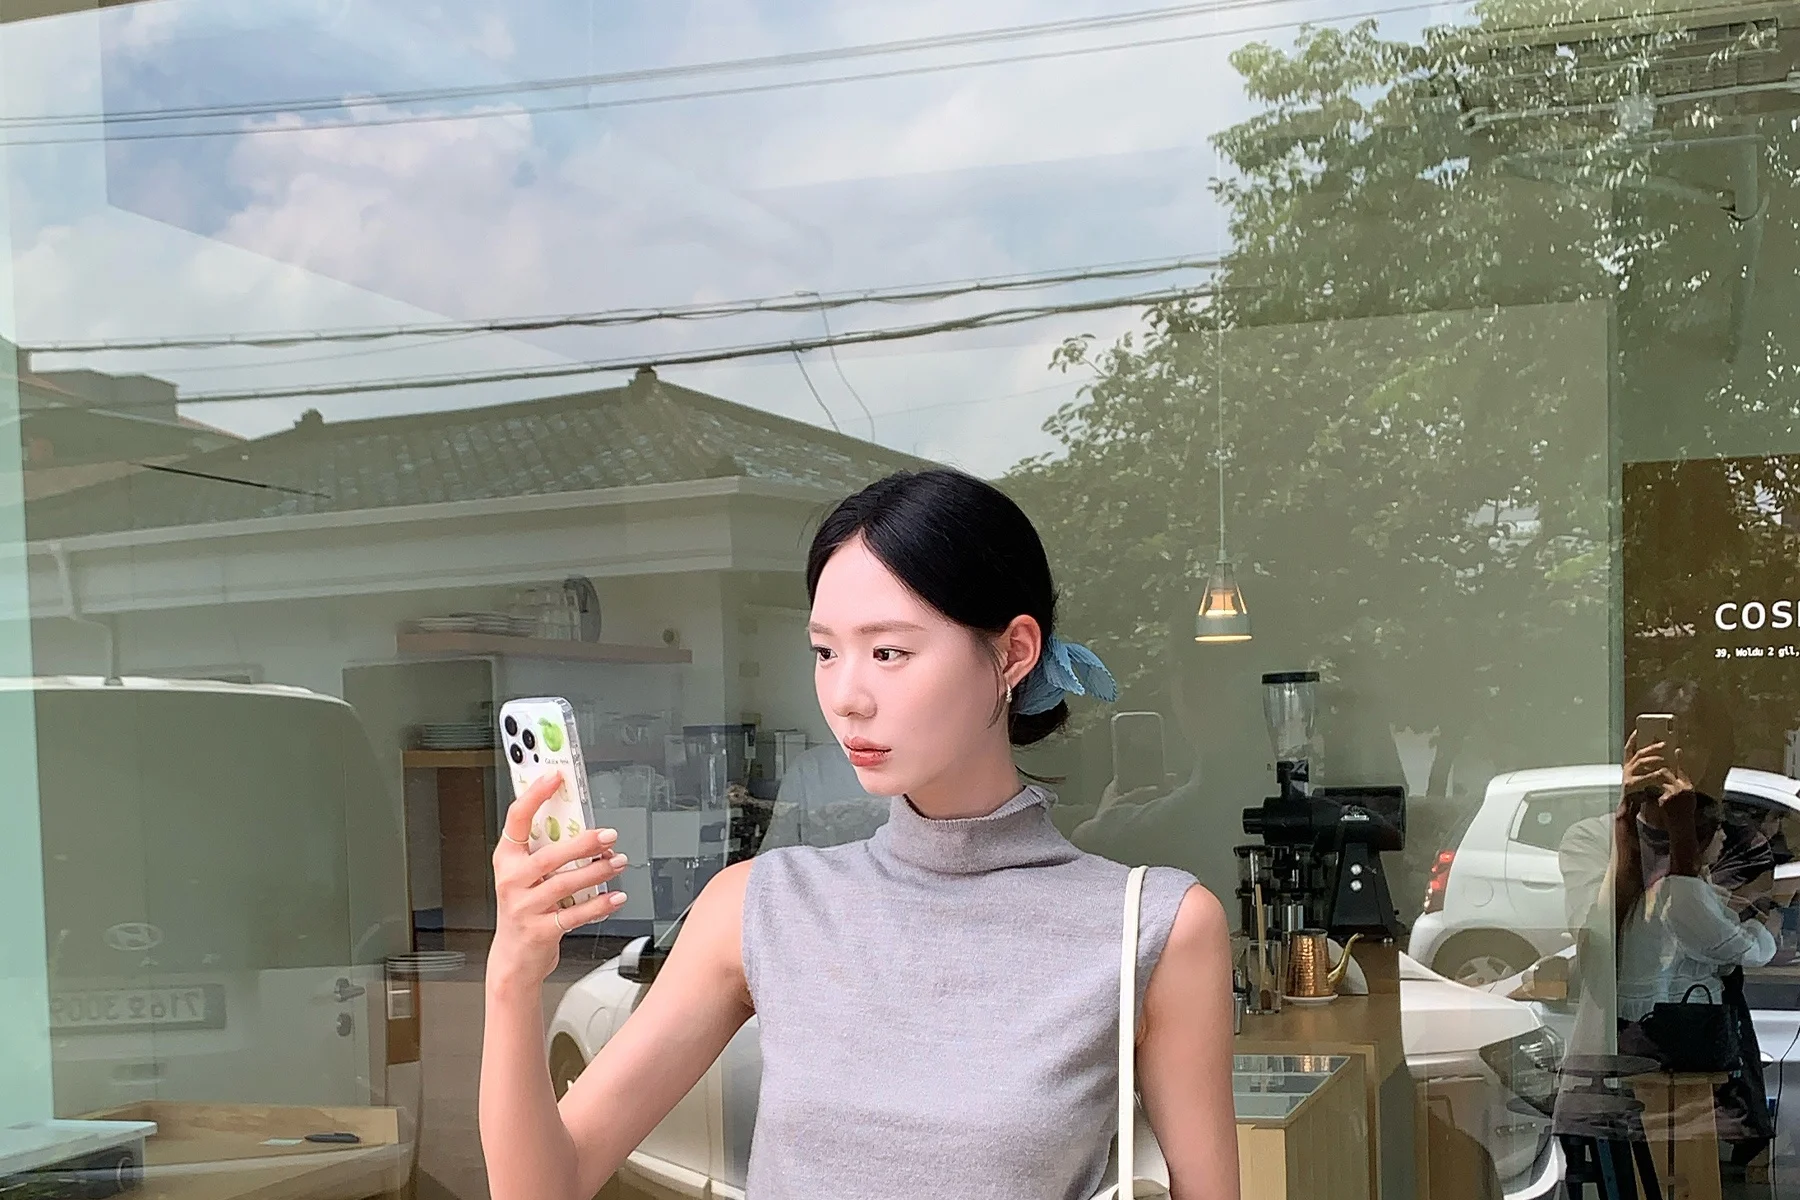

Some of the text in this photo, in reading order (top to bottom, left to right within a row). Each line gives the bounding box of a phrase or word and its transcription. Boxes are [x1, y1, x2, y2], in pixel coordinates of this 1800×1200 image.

[1714, 600, 1800, 631] COS
[1714, 648, 1731, 659] 39,
[1735, 647, 1764, 658] Woldu
[1767, 647, 1774, 656] 2
